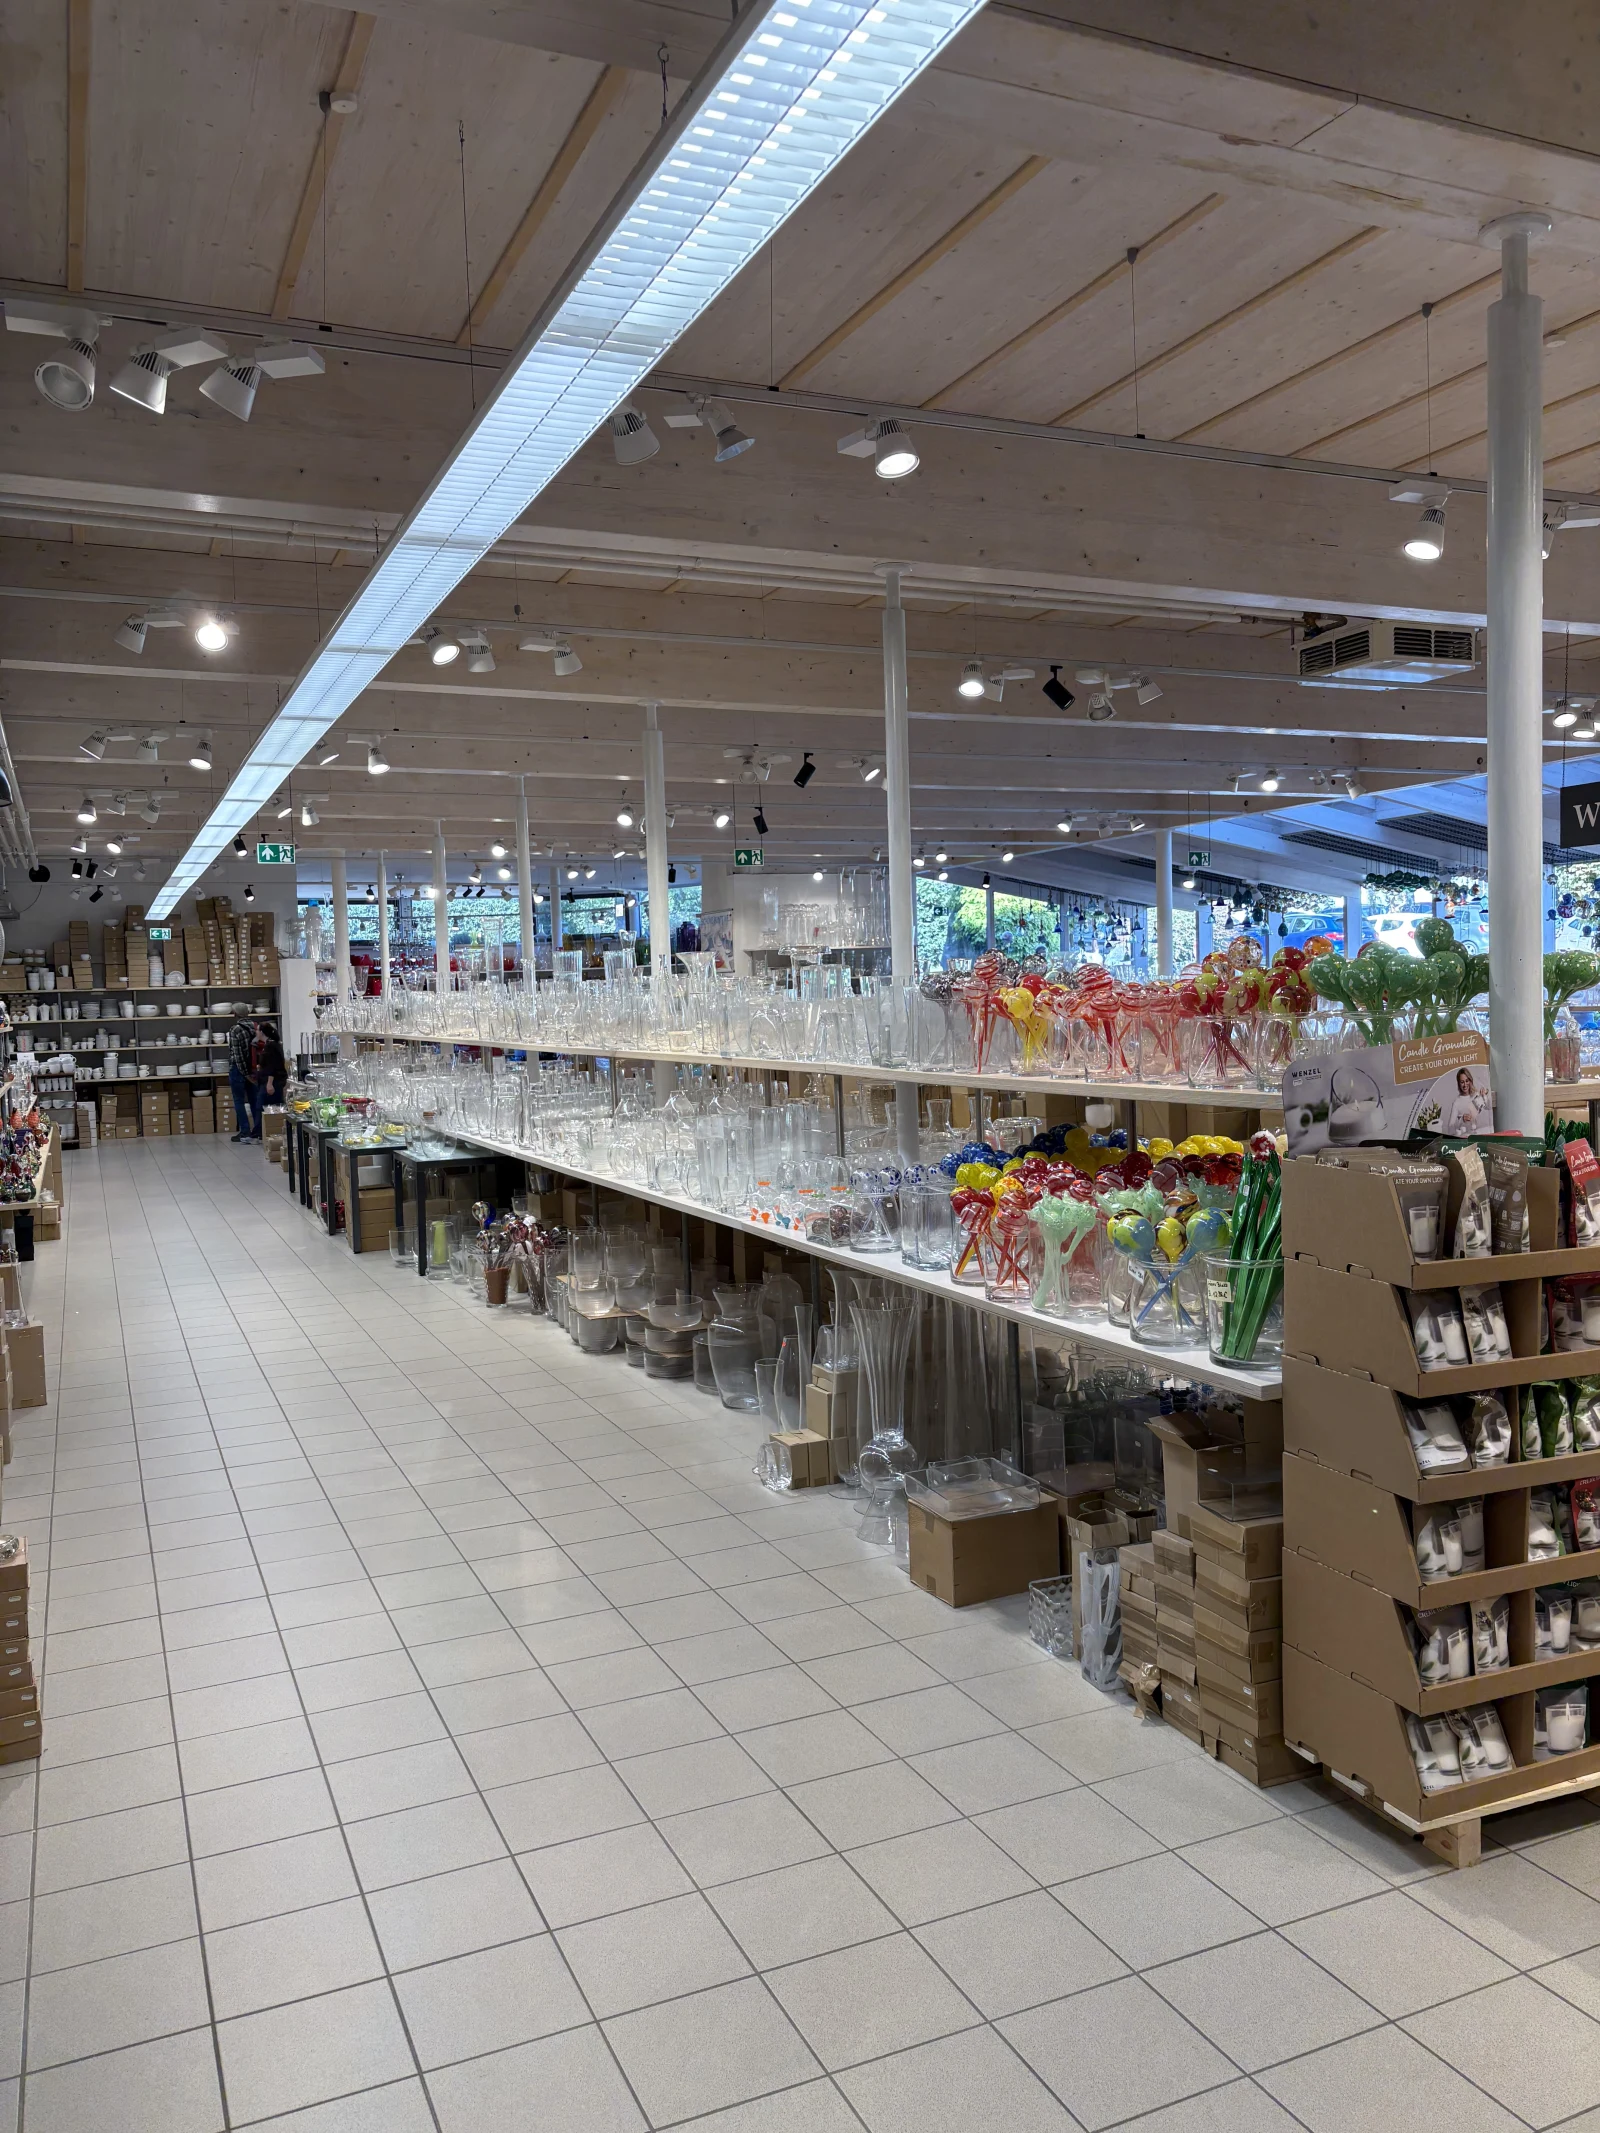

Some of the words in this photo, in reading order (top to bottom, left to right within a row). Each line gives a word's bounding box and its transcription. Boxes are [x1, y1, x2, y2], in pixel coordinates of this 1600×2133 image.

[1398, 1042, 1429, 1061] Candle
[1432, 1034, 1478, 1054] Granulate
[1400, 1062, 1424, 1074] CREATE
[1425, 1059, 1443, 1070] YOUR
[1443, 1056, 1459, 1066] OWN
[1459, 1053, 1478, 1063] LIGHT
[1291, 1067, 1322, 1078] WENZEL
[1408, 1165, 1445, 1176] Granulate
